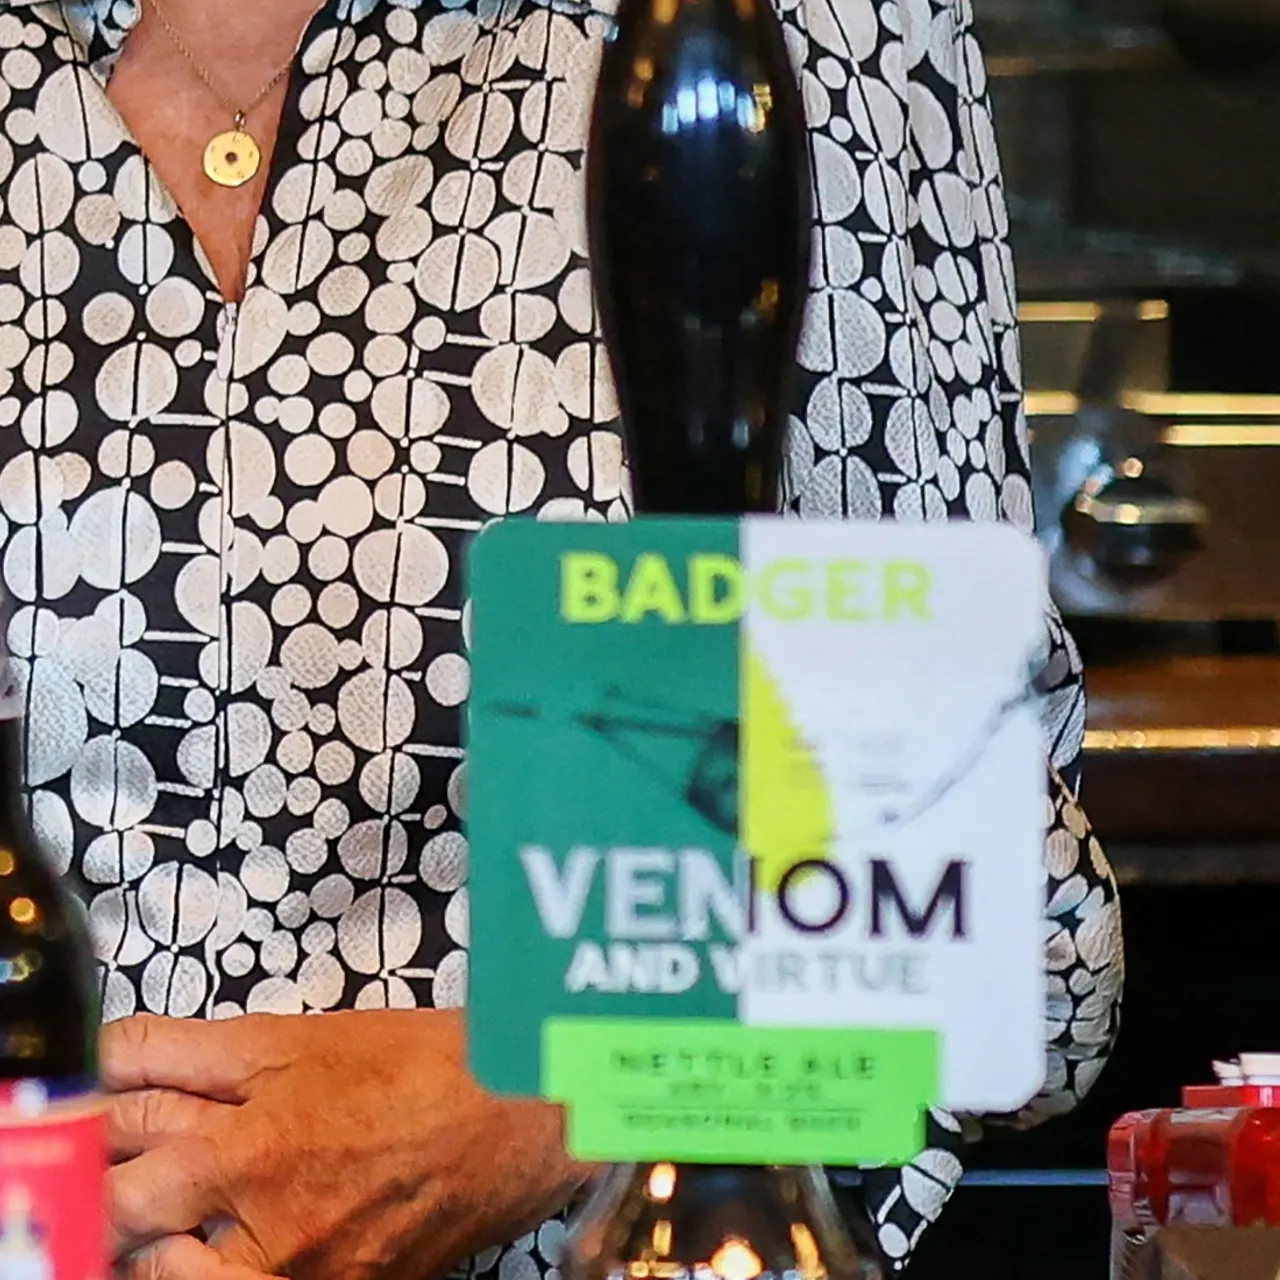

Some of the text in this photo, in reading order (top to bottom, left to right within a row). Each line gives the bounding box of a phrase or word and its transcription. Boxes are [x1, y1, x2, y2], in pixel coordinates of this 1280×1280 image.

[560, 553, 931, 623] BADGER
[519, 845, 973, 942] VENOM
[565, 941, 931, 994] AND VIRTUE
